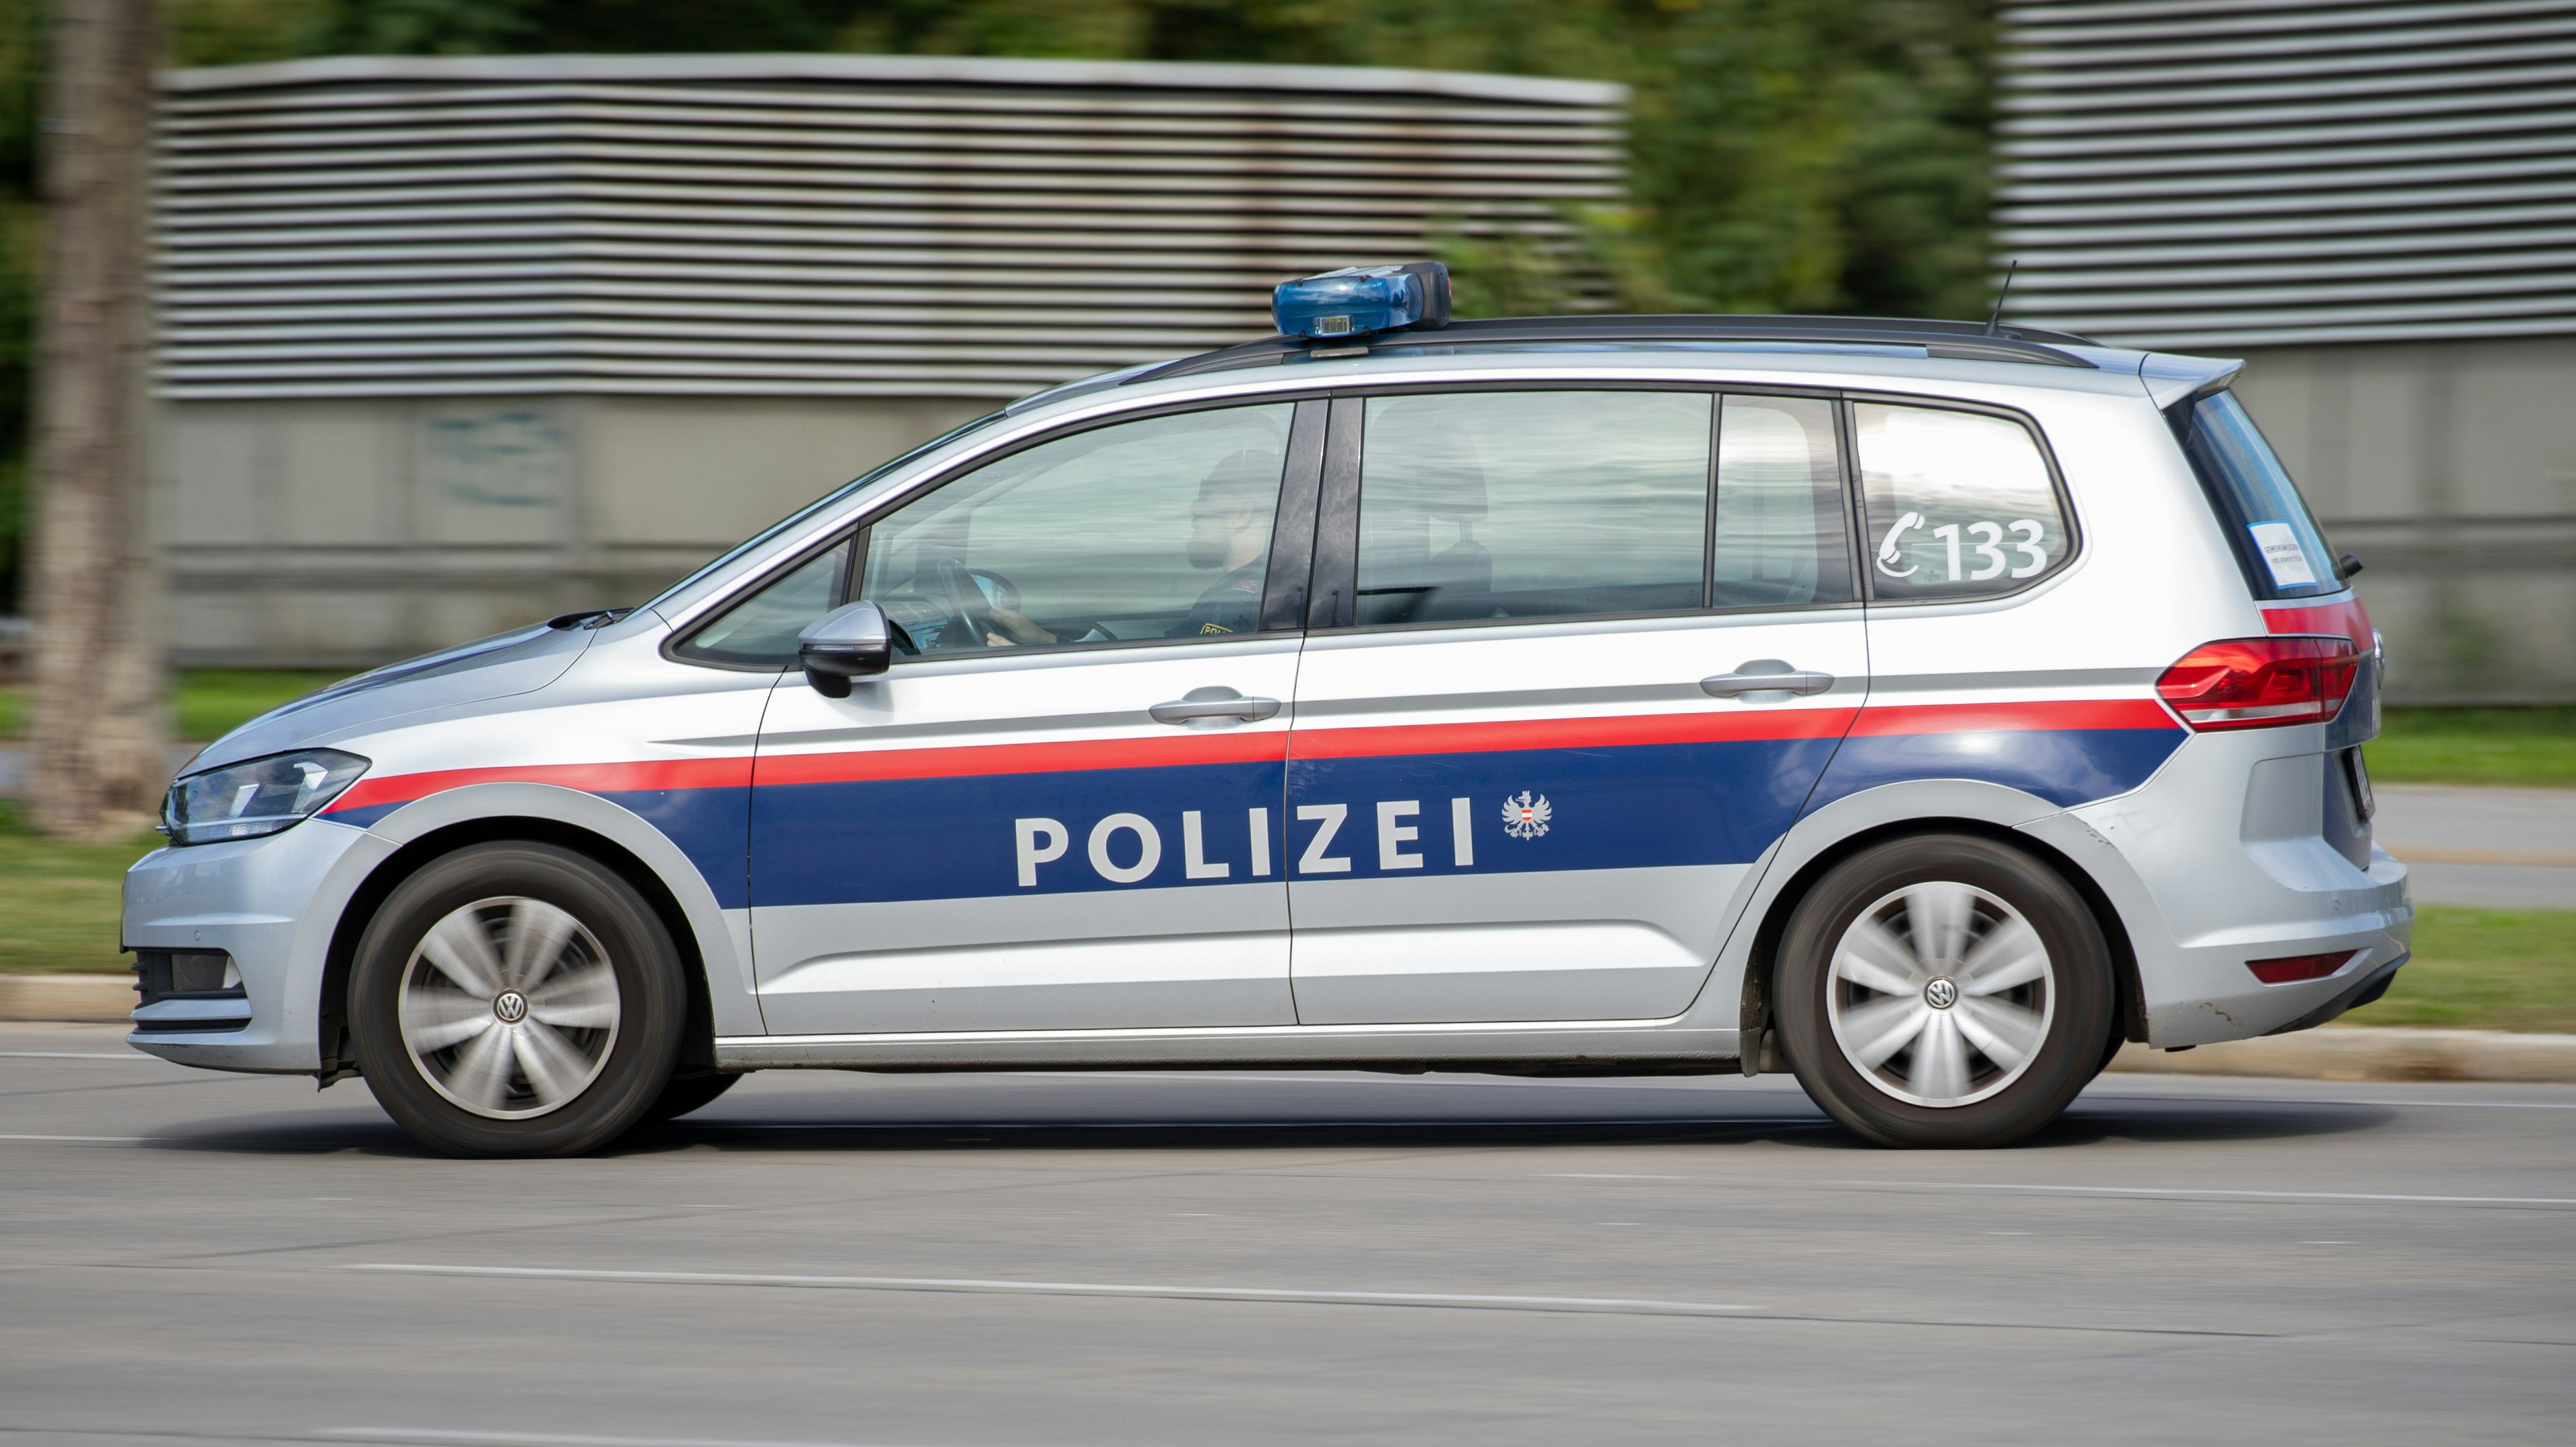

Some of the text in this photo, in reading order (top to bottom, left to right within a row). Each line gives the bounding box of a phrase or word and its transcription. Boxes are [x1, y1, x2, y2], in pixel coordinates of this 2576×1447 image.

[1933, 519, 2047, 581] 133
[1015, 798, 1473, 887] POLIZEI
[497, 992, 525, 1021] VW
[1927, 979, 1955, 1008] VW
